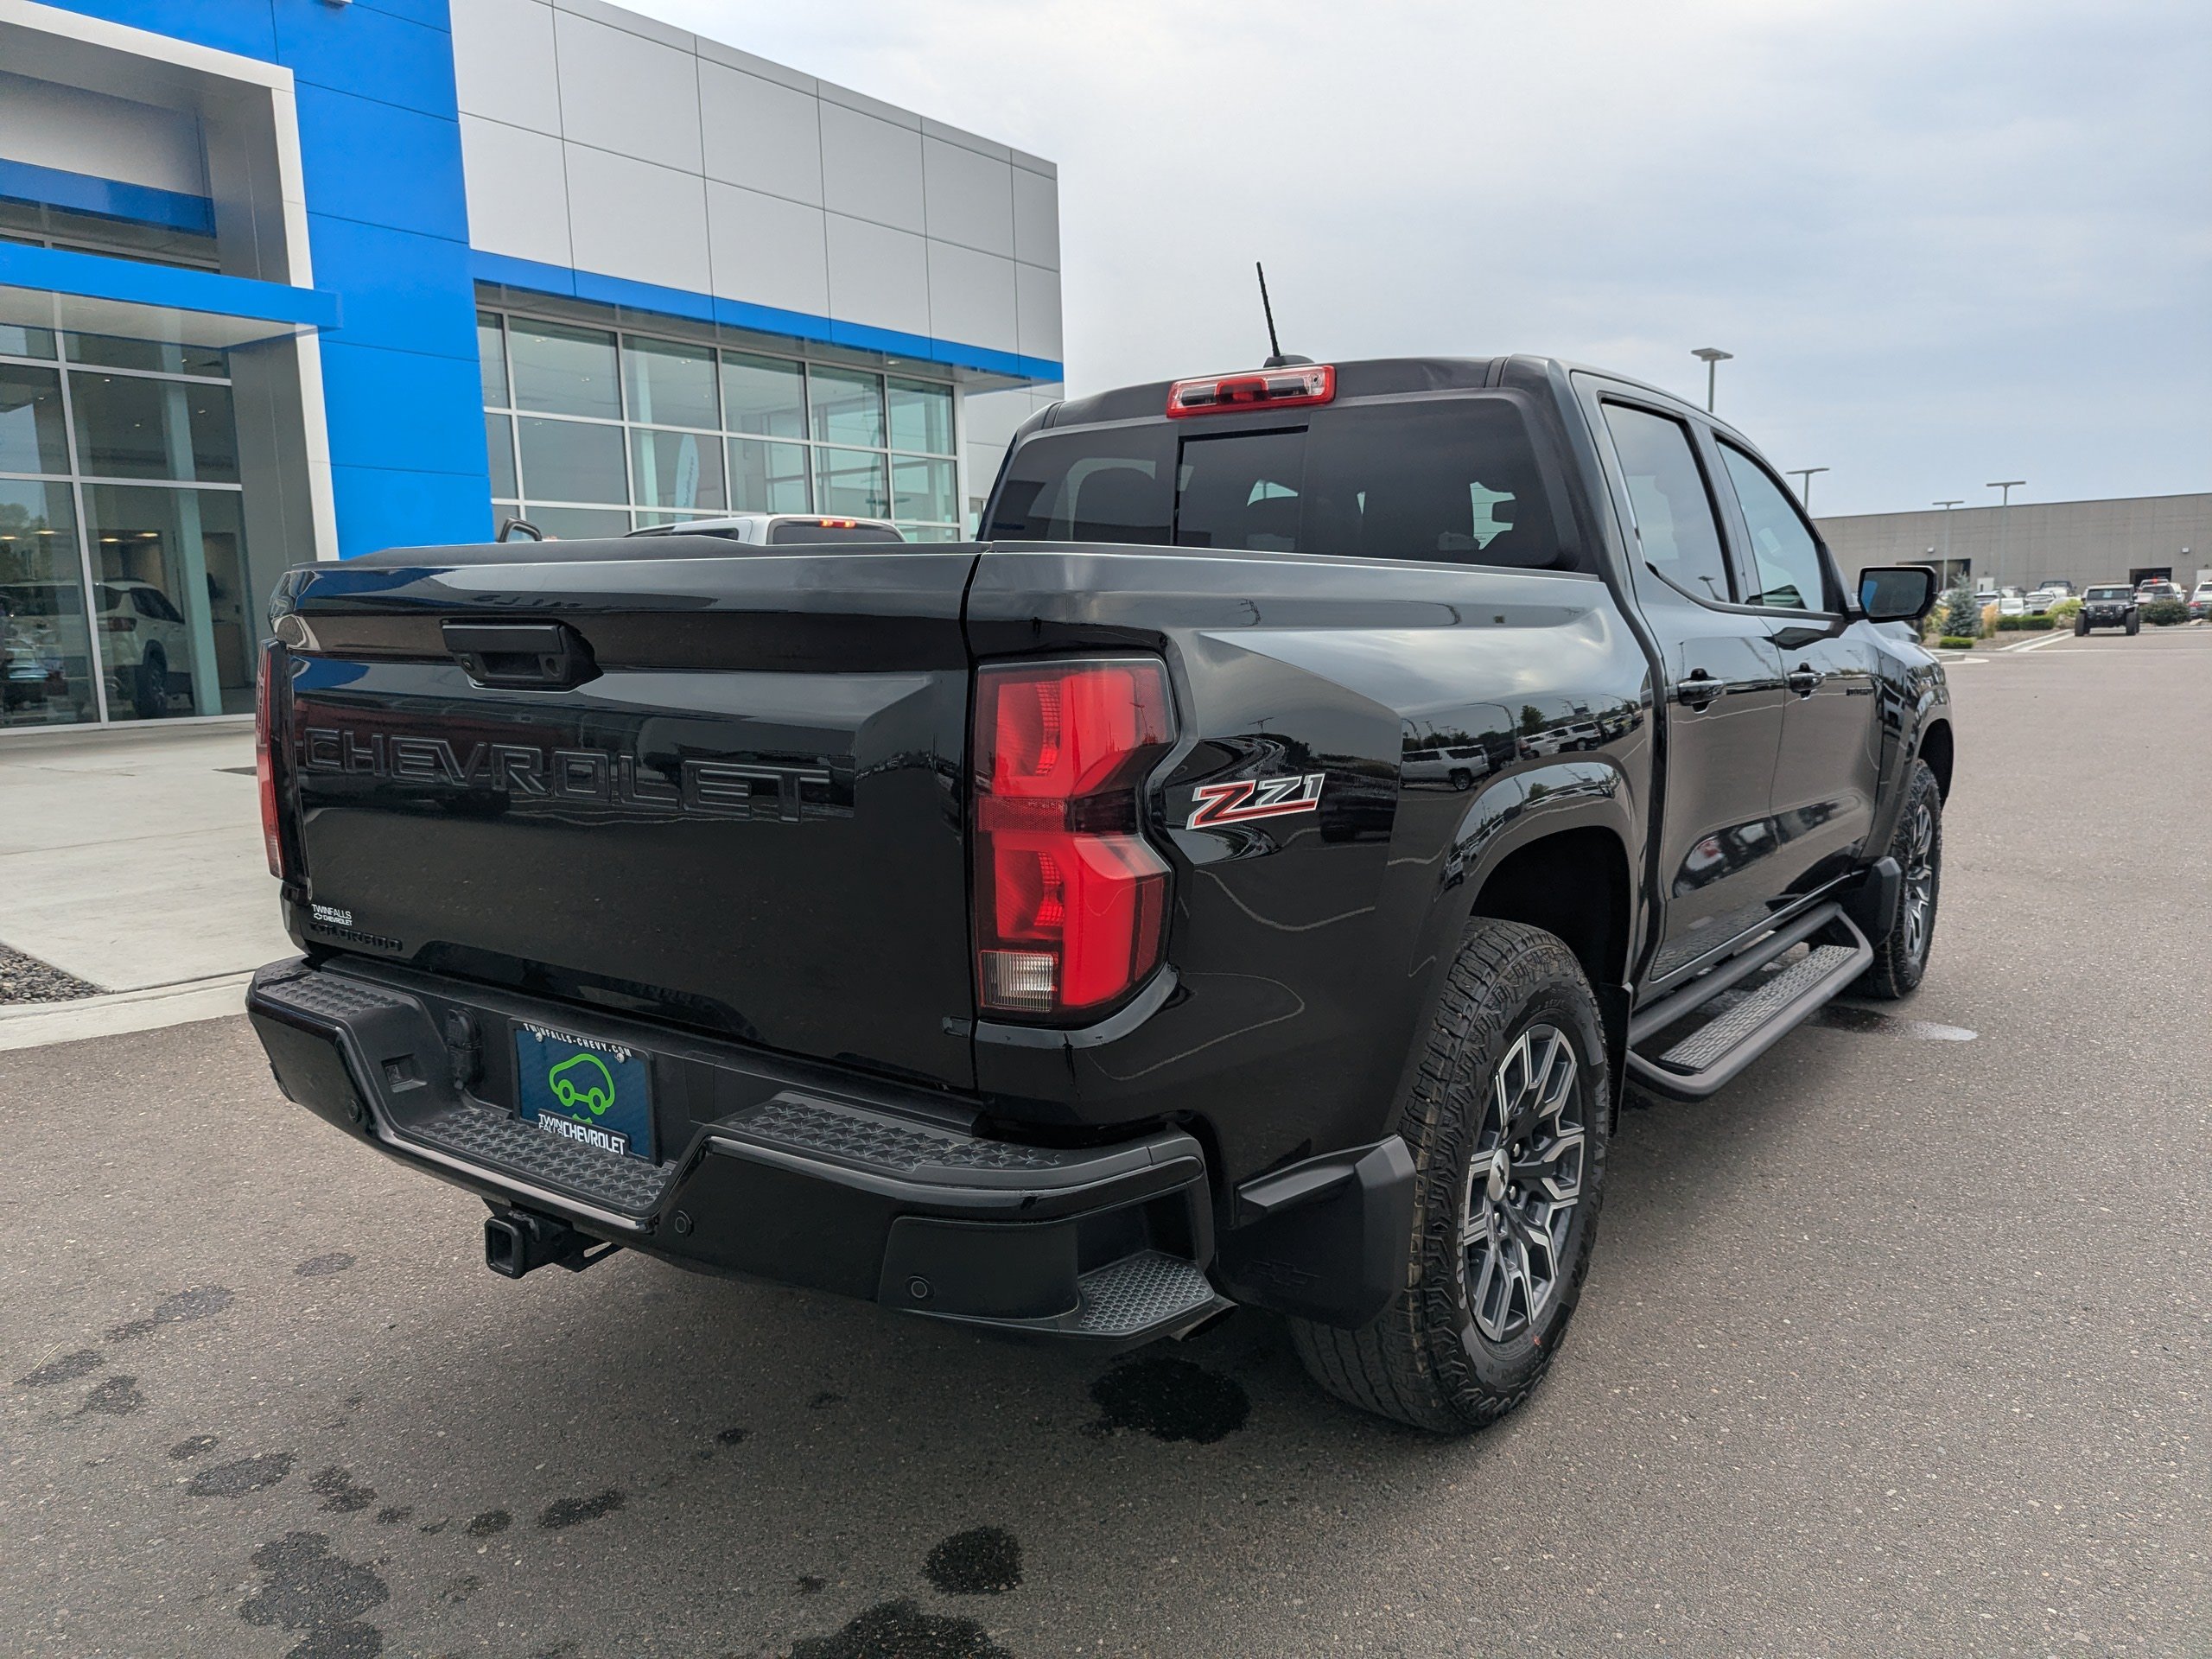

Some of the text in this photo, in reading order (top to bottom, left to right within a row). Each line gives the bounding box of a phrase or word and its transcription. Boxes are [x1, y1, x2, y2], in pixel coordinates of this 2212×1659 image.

[305, 728, 831, 824] CHEVROLET
[1186, 773, 1325, 830] Z71
[322, 915, 353, 926] CHEVROLET
[538, 1114, 563, 1128] TWIN
[563, 1121, 626, 1155] CHEVROLET
